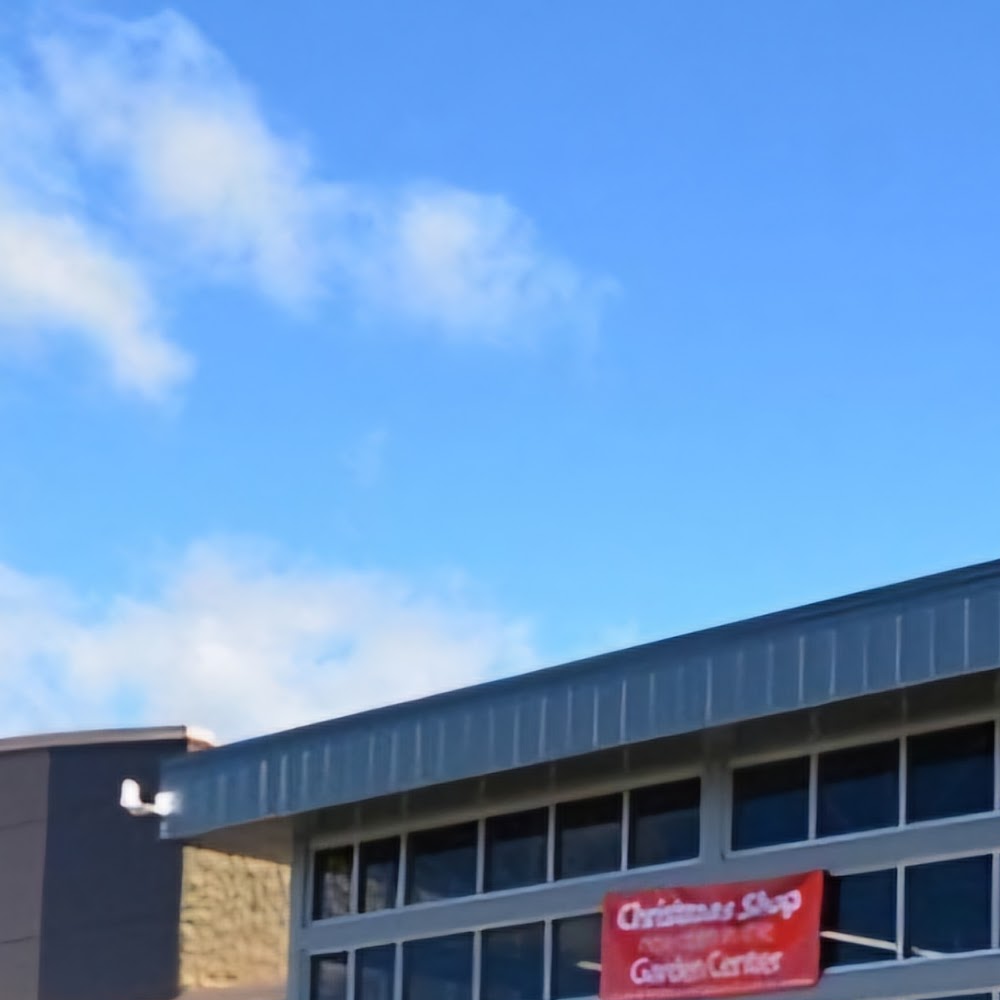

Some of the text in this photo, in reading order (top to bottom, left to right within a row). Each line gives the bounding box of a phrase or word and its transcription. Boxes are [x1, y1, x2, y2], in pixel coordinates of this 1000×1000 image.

[617, 888, 803, 931] Christmas Shop
[630, 950, 783, 985] Garden Center
